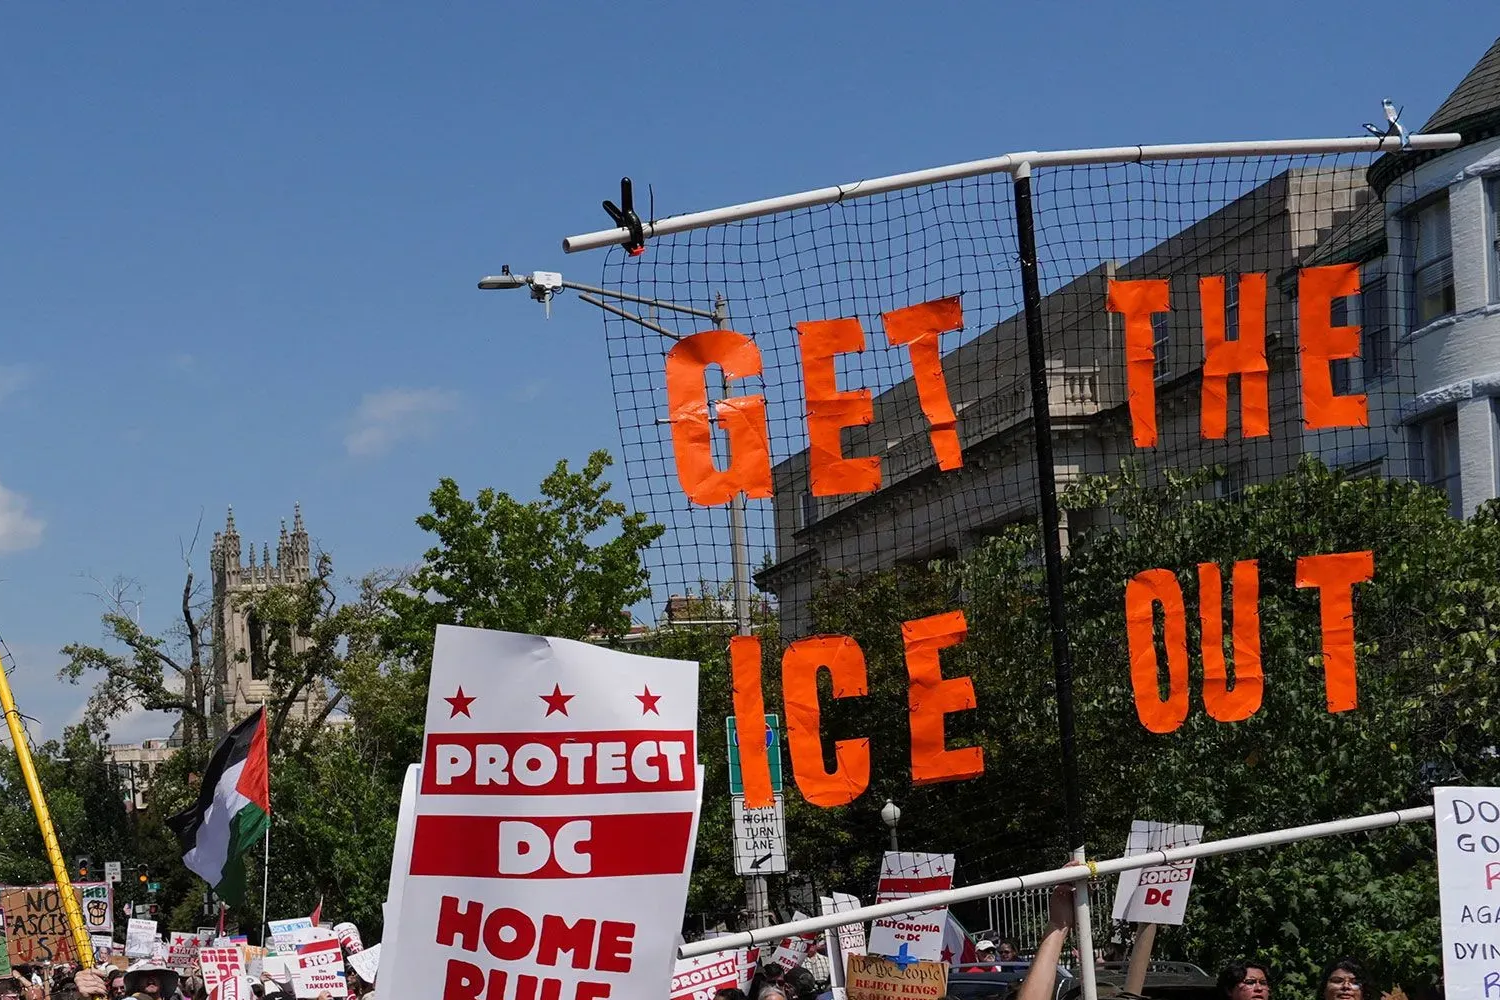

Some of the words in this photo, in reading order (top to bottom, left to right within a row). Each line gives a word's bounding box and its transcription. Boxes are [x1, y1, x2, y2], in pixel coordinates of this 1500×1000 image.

[666, 296, 964, 507] GET
[1107, 263, 1369, 448] THE
[729, 610, 985, 809] ICE
[1124, 551, 1374, 734] OUT
[435, 740, 687, 786] PROTECT
[743, 814, 774, 825] RIGHT
[745, 828, 774, 837] TURN
[498, 820, 593, 875] DC
[746, 840, 775, 850] LANE
[1140, 870, 1189, 886] SOMOS
[26, 890, 60, 912] NO
[1144, 888, 1173, 907] DC
[6, 913, 72, 937] FASCIS
[435, 895, 636, 974] HOME
[875, 919, 940, 933] AUTONOMÍA
[906, 933, 921, 941] DC
[670, 961, 735, 991] PROTECT
[855, 978, 899, 992] REJECT
[901, 983, 938, 996] KINGS
